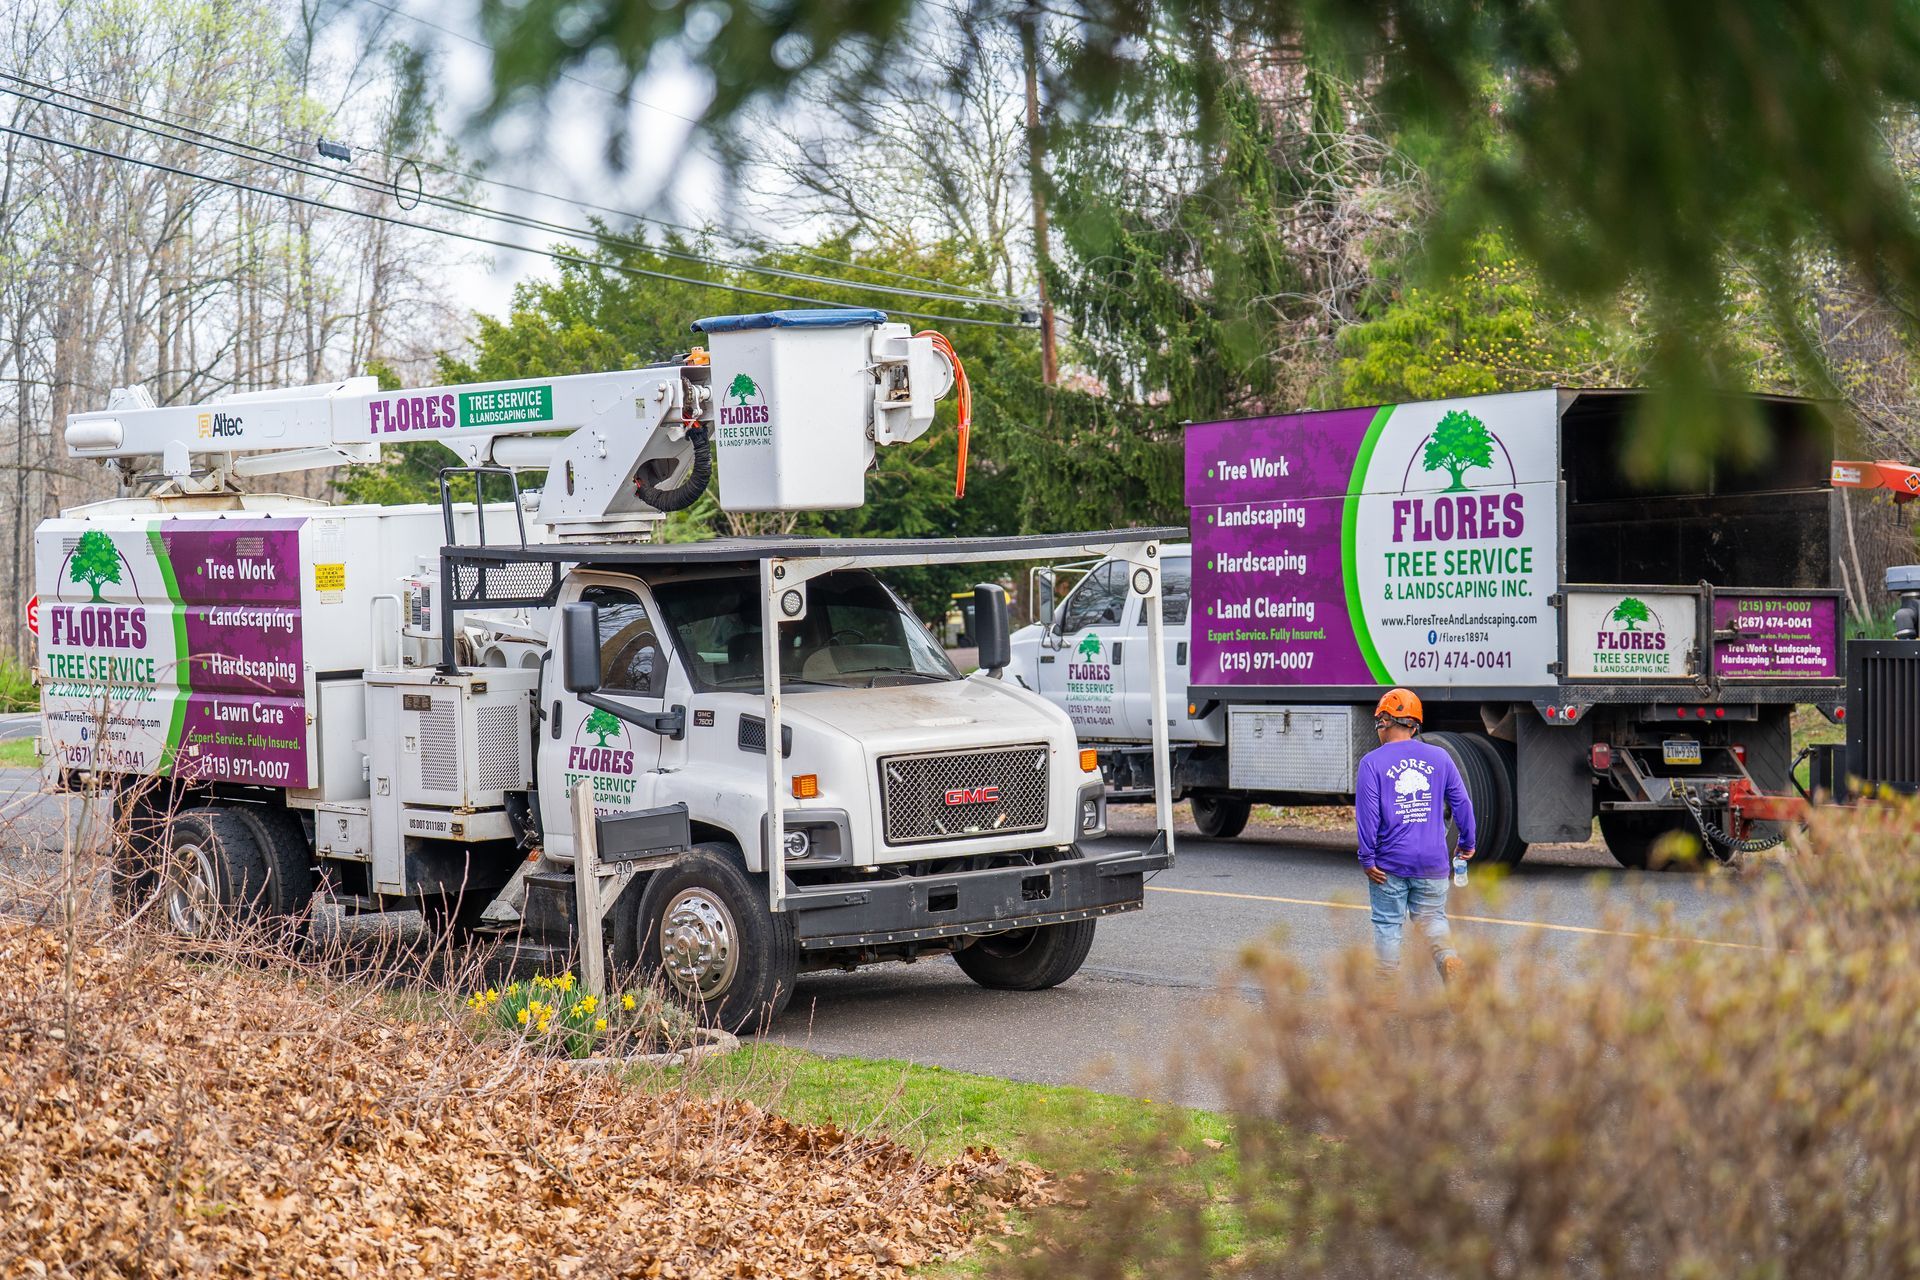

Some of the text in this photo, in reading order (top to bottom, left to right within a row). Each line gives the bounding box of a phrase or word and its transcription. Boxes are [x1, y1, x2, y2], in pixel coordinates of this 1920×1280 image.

[468, 390, 542, 410] TREE SERVICE
[370, 394, 456, 434] FLORES
[470, 408, 542, 423] & LANDSCAPING INC.
[720, 406, 768, 424] FLORES
[212, 413, 242, 437] Altec
[718, 426, 772, 438] TREE SERVICE
[724, 438, 761, 446] LANDSCAPING
[1217, 456, 1289, 480] Tree Work
[1218, 504, 1306, 528] Landscaping
[1392, 492, 1524, 542] FLORES
[206, 558, 276, 580] Tree Work
[1217, 550, 1306, 576] Hardscaping
[1384, 547, 1532, 578] TREE SERVICE
[1384, 580, 1532, 600] & LANDSCAPING INC.
[1217, 597, 1314, 622] Land Clearing
[1738, 600, 1811, 612] (215) 971-0007
[51, 606, 147, 649] FLORES
[209, 606, 294, 633] Landscaping
[1382, 614, 1537, 628] www.FloresTreeAndLandscaping.com
[1738, 616, 1812, 628] (267) 474-0041
[1208, 627, 1326, 643] Expert Service. Fully Insured.
[1439, 632, 1488, 644] /flores18974
[1598, 632, 1666, 650] FLORES
[1593, 653, 1670, 664] TREE SERVICE
[1728, 644, 1821, 655] Tree Work Landscaping
[48, 654, 156, 682] TREE SERVICE
[212, 655, 296, 684] Hardscaping
[1220, 652, 1314, 672] (215) 971-0007
[1404, 650, 1512, 672] (267) 474-0041
[1722, 655, 1826, 666] Hardscaping Land Clearing
[1069, 664, 1110, 680] FLORES
[49, 682, 156, 702] & LANDSCAPING INC.
[1066, 683, 1114, 694] TREE SERVICE
[214, 700, 284, 724] Lawn Care
[1068, 704, 1110, 714] (215) 971-0007
[189, 732, 300, 750] Expert Service. Fully Insured.
[65, 745, 91, 766] (267)
[568, 746, 634, 775] FLORES
[202, 754, 290, 780] (215) 971-0007
[1386, 758, 1434, 780] FLORES
[564, 773, 590, 786] TR
[566, 790, 570, 799] &
[945, 786, 1000, 806] GMC
[426, 820, 446, 832] 3111897
[615, 860, 634, 885] 99
